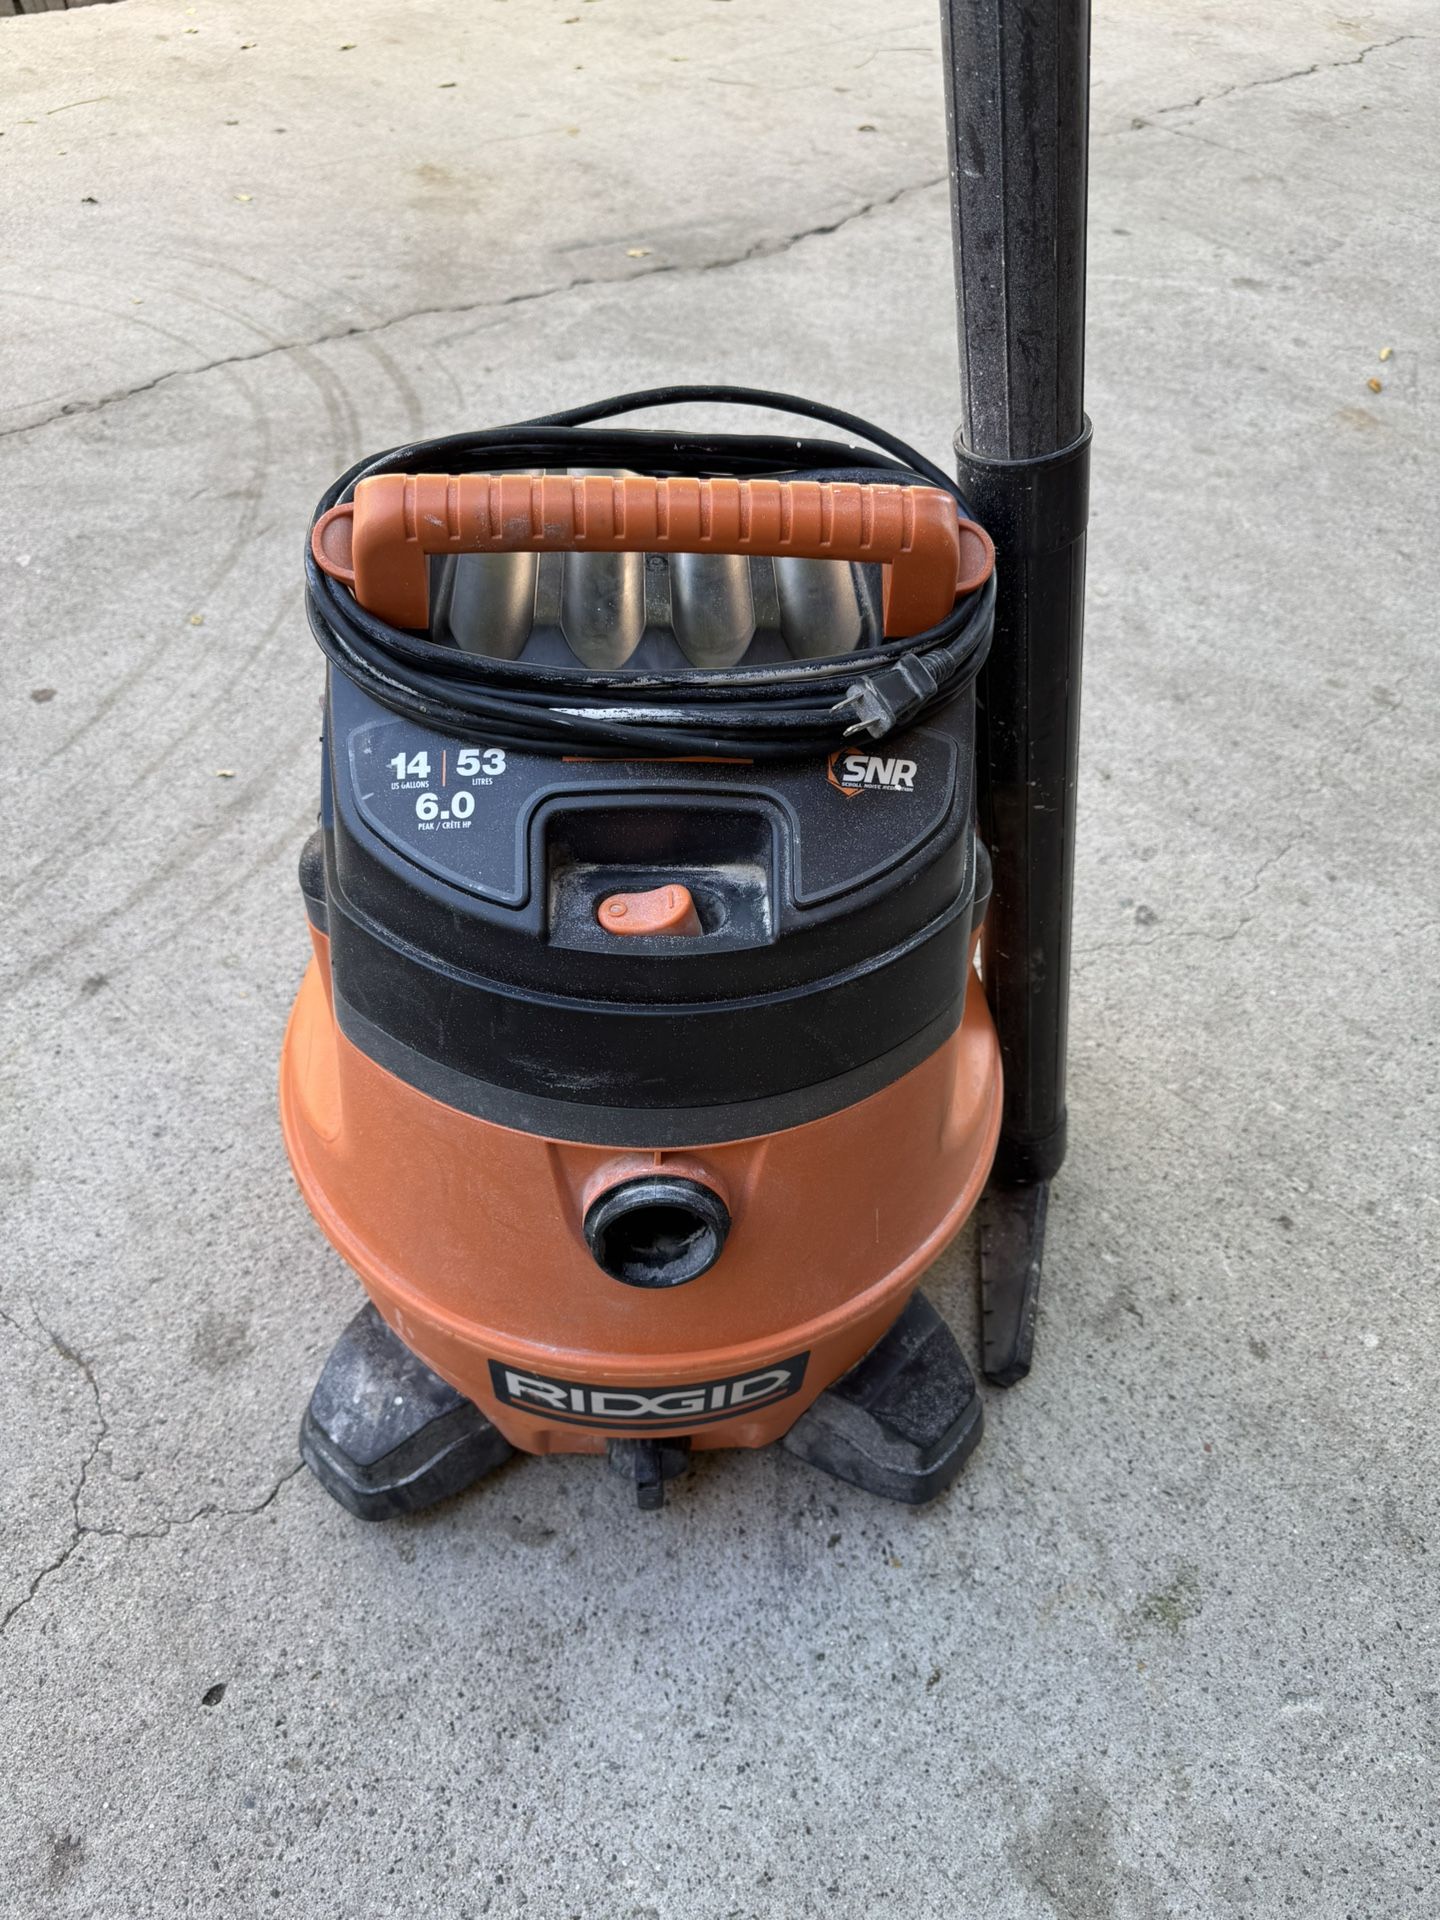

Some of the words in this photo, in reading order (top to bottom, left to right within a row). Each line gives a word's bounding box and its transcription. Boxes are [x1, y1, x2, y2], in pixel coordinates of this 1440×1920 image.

[391, 751, 431, 779] 14
[456, 748, 506, 776] 53
[843, 755, 917, 787] SNR
[401, 781, 430, 789] GALLONS
[472, 778, 493, 786] LITRES
[415, 791, 475, 820] 6.0
[462, 821, 472, 829] HP
[504, 1369, 791, 1417] RIDGID
